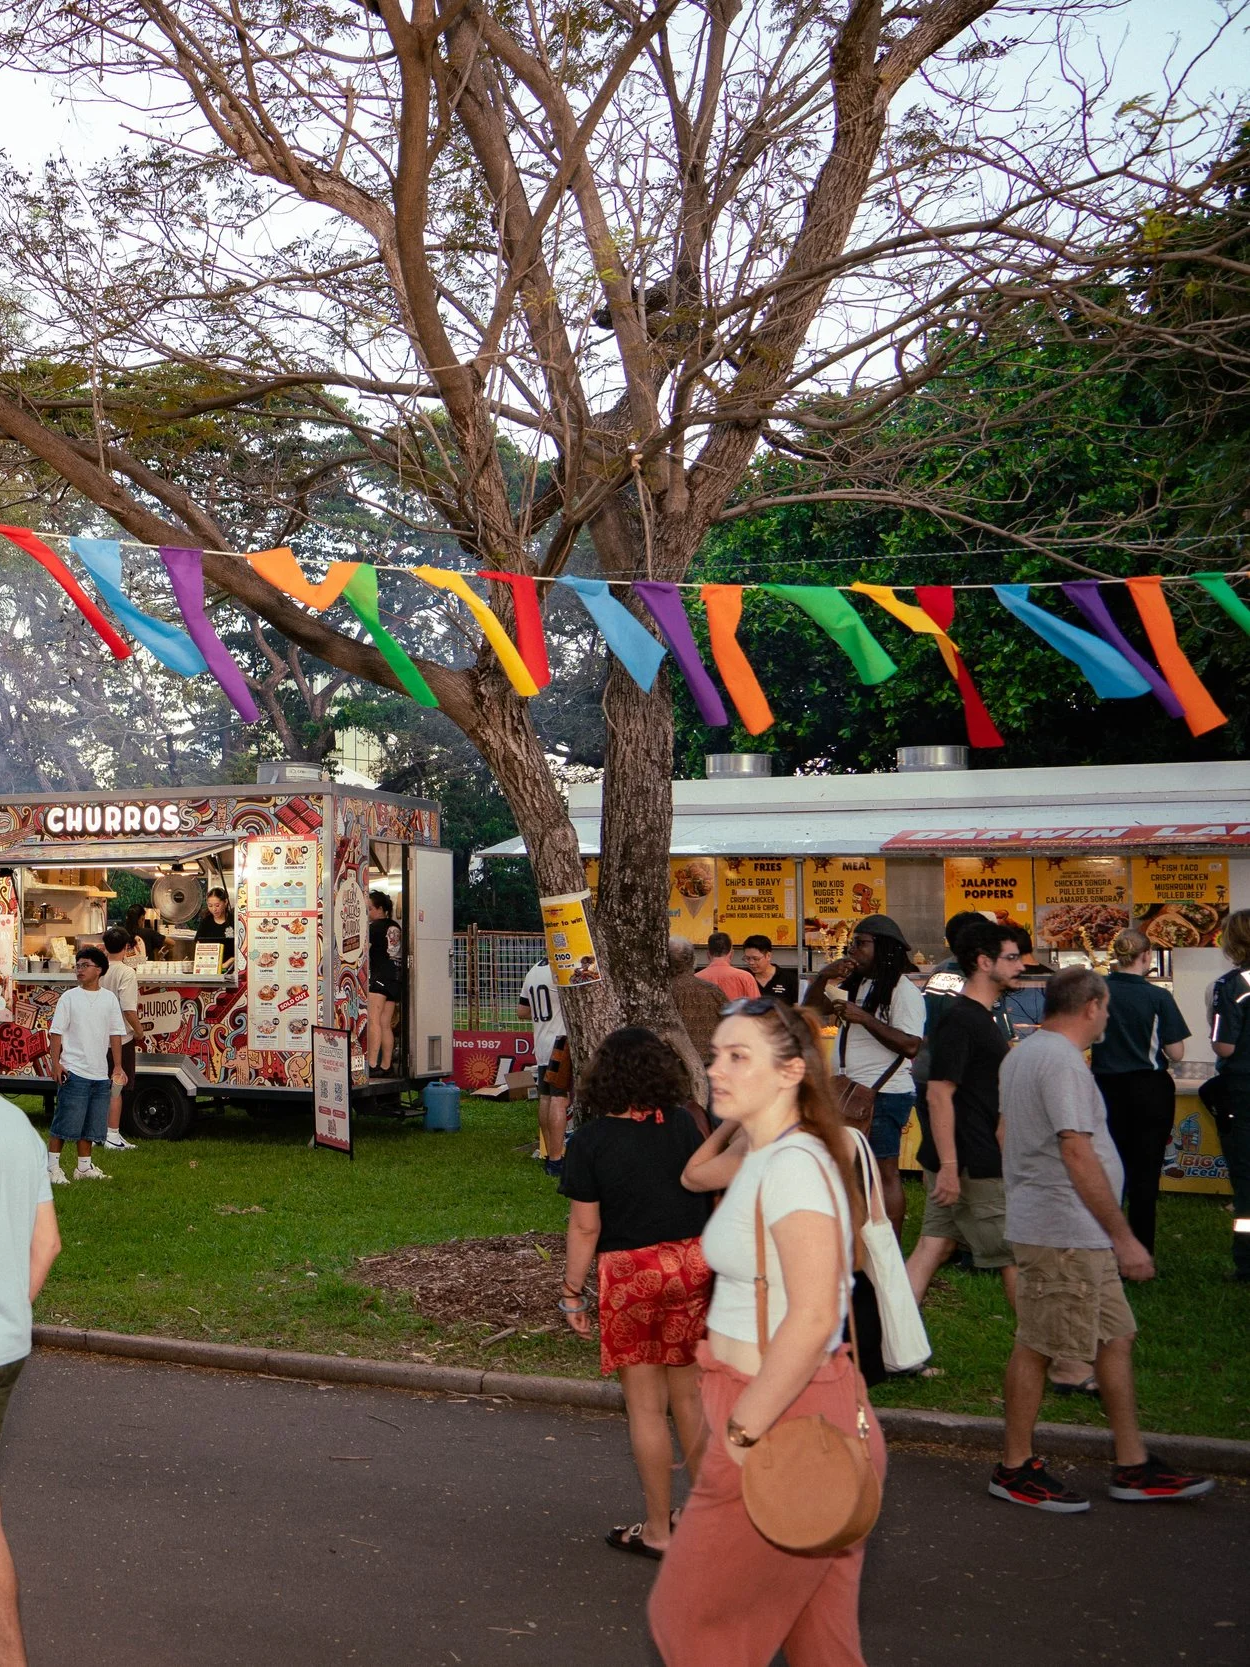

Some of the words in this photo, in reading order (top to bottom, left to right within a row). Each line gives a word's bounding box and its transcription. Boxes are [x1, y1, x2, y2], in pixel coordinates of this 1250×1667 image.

[47, 805, 180, 832] CHURROS
[907, 828, 1130, 840] DARWIN
[753, 862, 783, 872] FRIES
[842, 861, 872, 871] MEAL
[1161, 864, 1178, 872] FISH
[1180, 864, 1198, 872] TACO
[1178, 873, 1209, 881] CHICKEN
[725, 878, 746, 887] CHIPS
[748, 879, 753, 887] &
[755, 878, 781, 887] GRAVY
[812, 880, 827, 888] DINO
[830, 880, 844, 888] KIDS
[961, 878, 1017, 888] JALAPENO
[1085, 879, 1111, 887] SONORA
[1154, 883, 1194, 891] MUSHROOM
[964, 890, 1014, 899] POPPERS
[1086, 887, 1104, 895] BEEF
[1046, 896, 1089, 904] CALAMARES
[554, 953, 571, 961] $100
[279, 1000, 295, 1010] SOLD
[294, 992, 307, 1002] OUT
[529, 984, 553, 1022] 10
[137, 1000, 178, 1020] CHURROS
[477, 1040, 501, 1049] 1987
[4, 1049, 27, 1065] LATE
[1182, 1154, 1214, 1168] BIG
[1186, 1167, 1217, 1177] Iced
